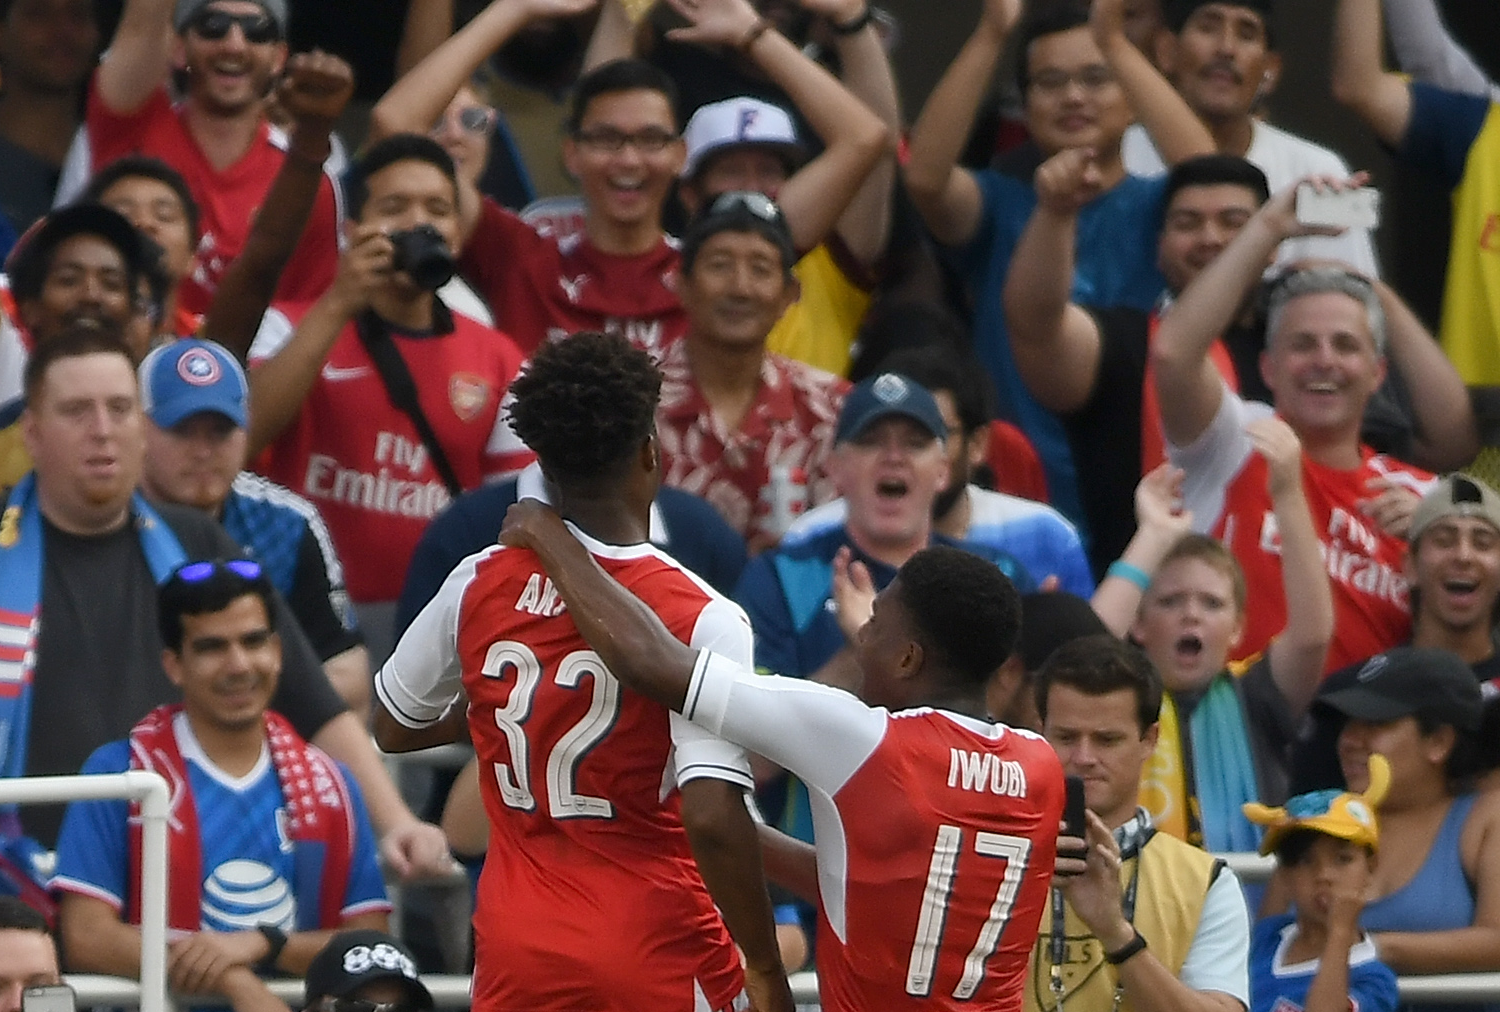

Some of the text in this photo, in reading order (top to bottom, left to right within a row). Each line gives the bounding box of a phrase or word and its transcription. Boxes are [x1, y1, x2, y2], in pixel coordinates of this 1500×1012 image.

[374, 430, 427, 474] Fly
[304, 453, 451, 519] Emirate
[514, 572, 567, 617] AK
[481, 640, 622, 821] 32
[905, 823, 1032, 1000] 17
